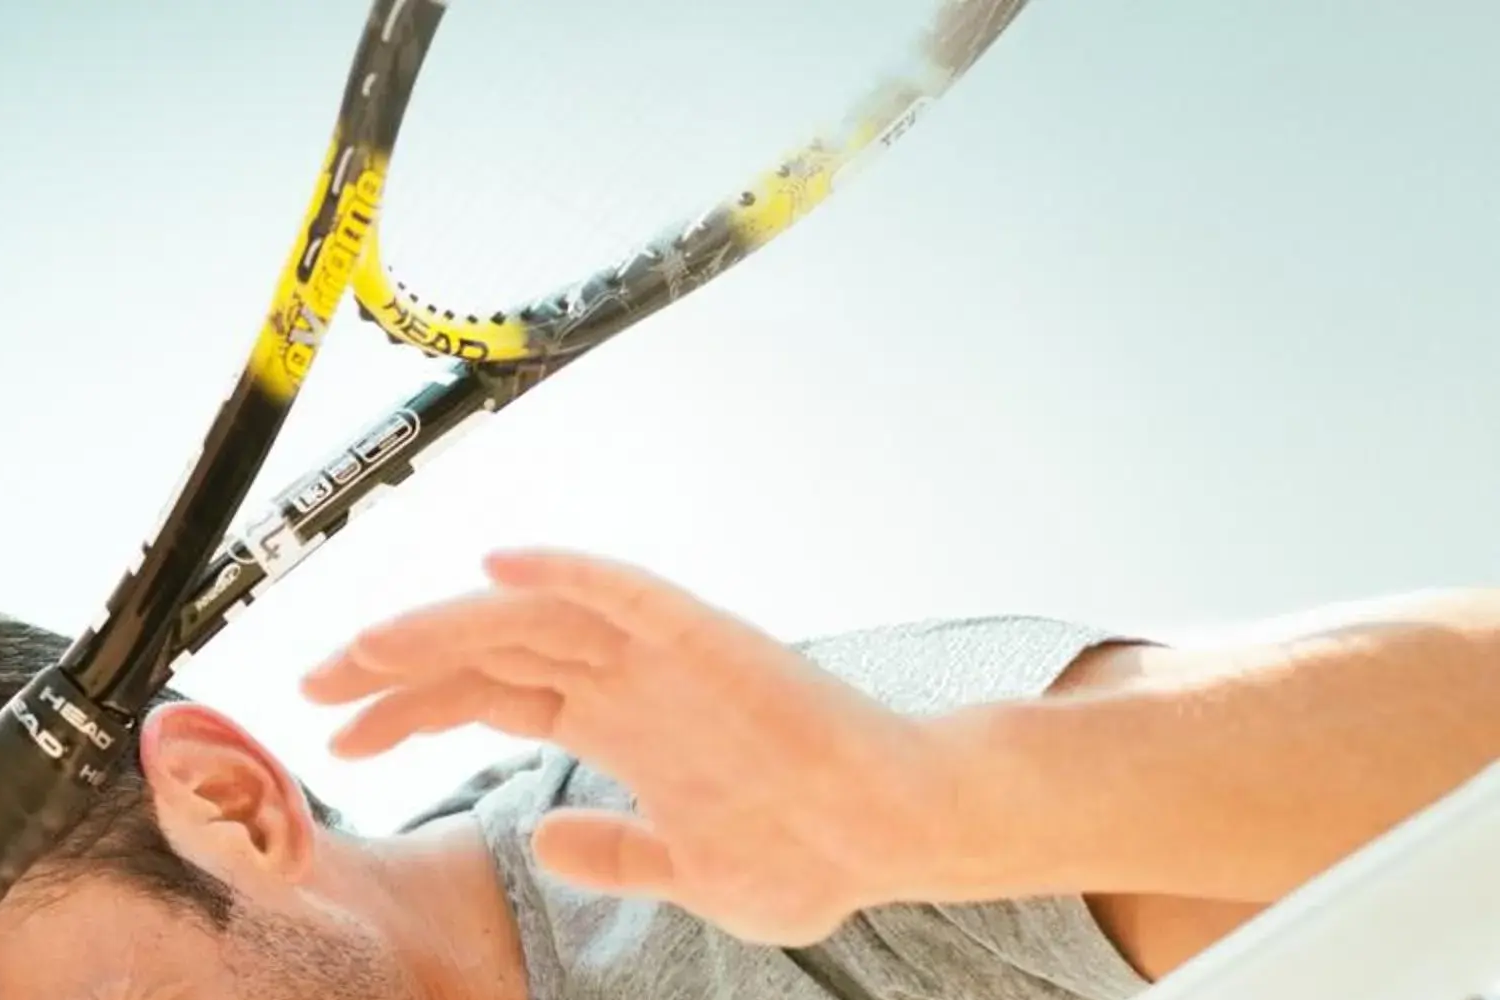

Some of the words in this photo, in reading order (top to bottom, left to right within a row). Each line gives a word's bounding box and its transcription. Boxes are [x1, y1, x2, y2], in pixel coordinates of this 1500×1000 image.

[383, 296, 490, 363] HEAD
[10, 699, 64, 759] EAD
[39, 686, 115, 750] HEAD
